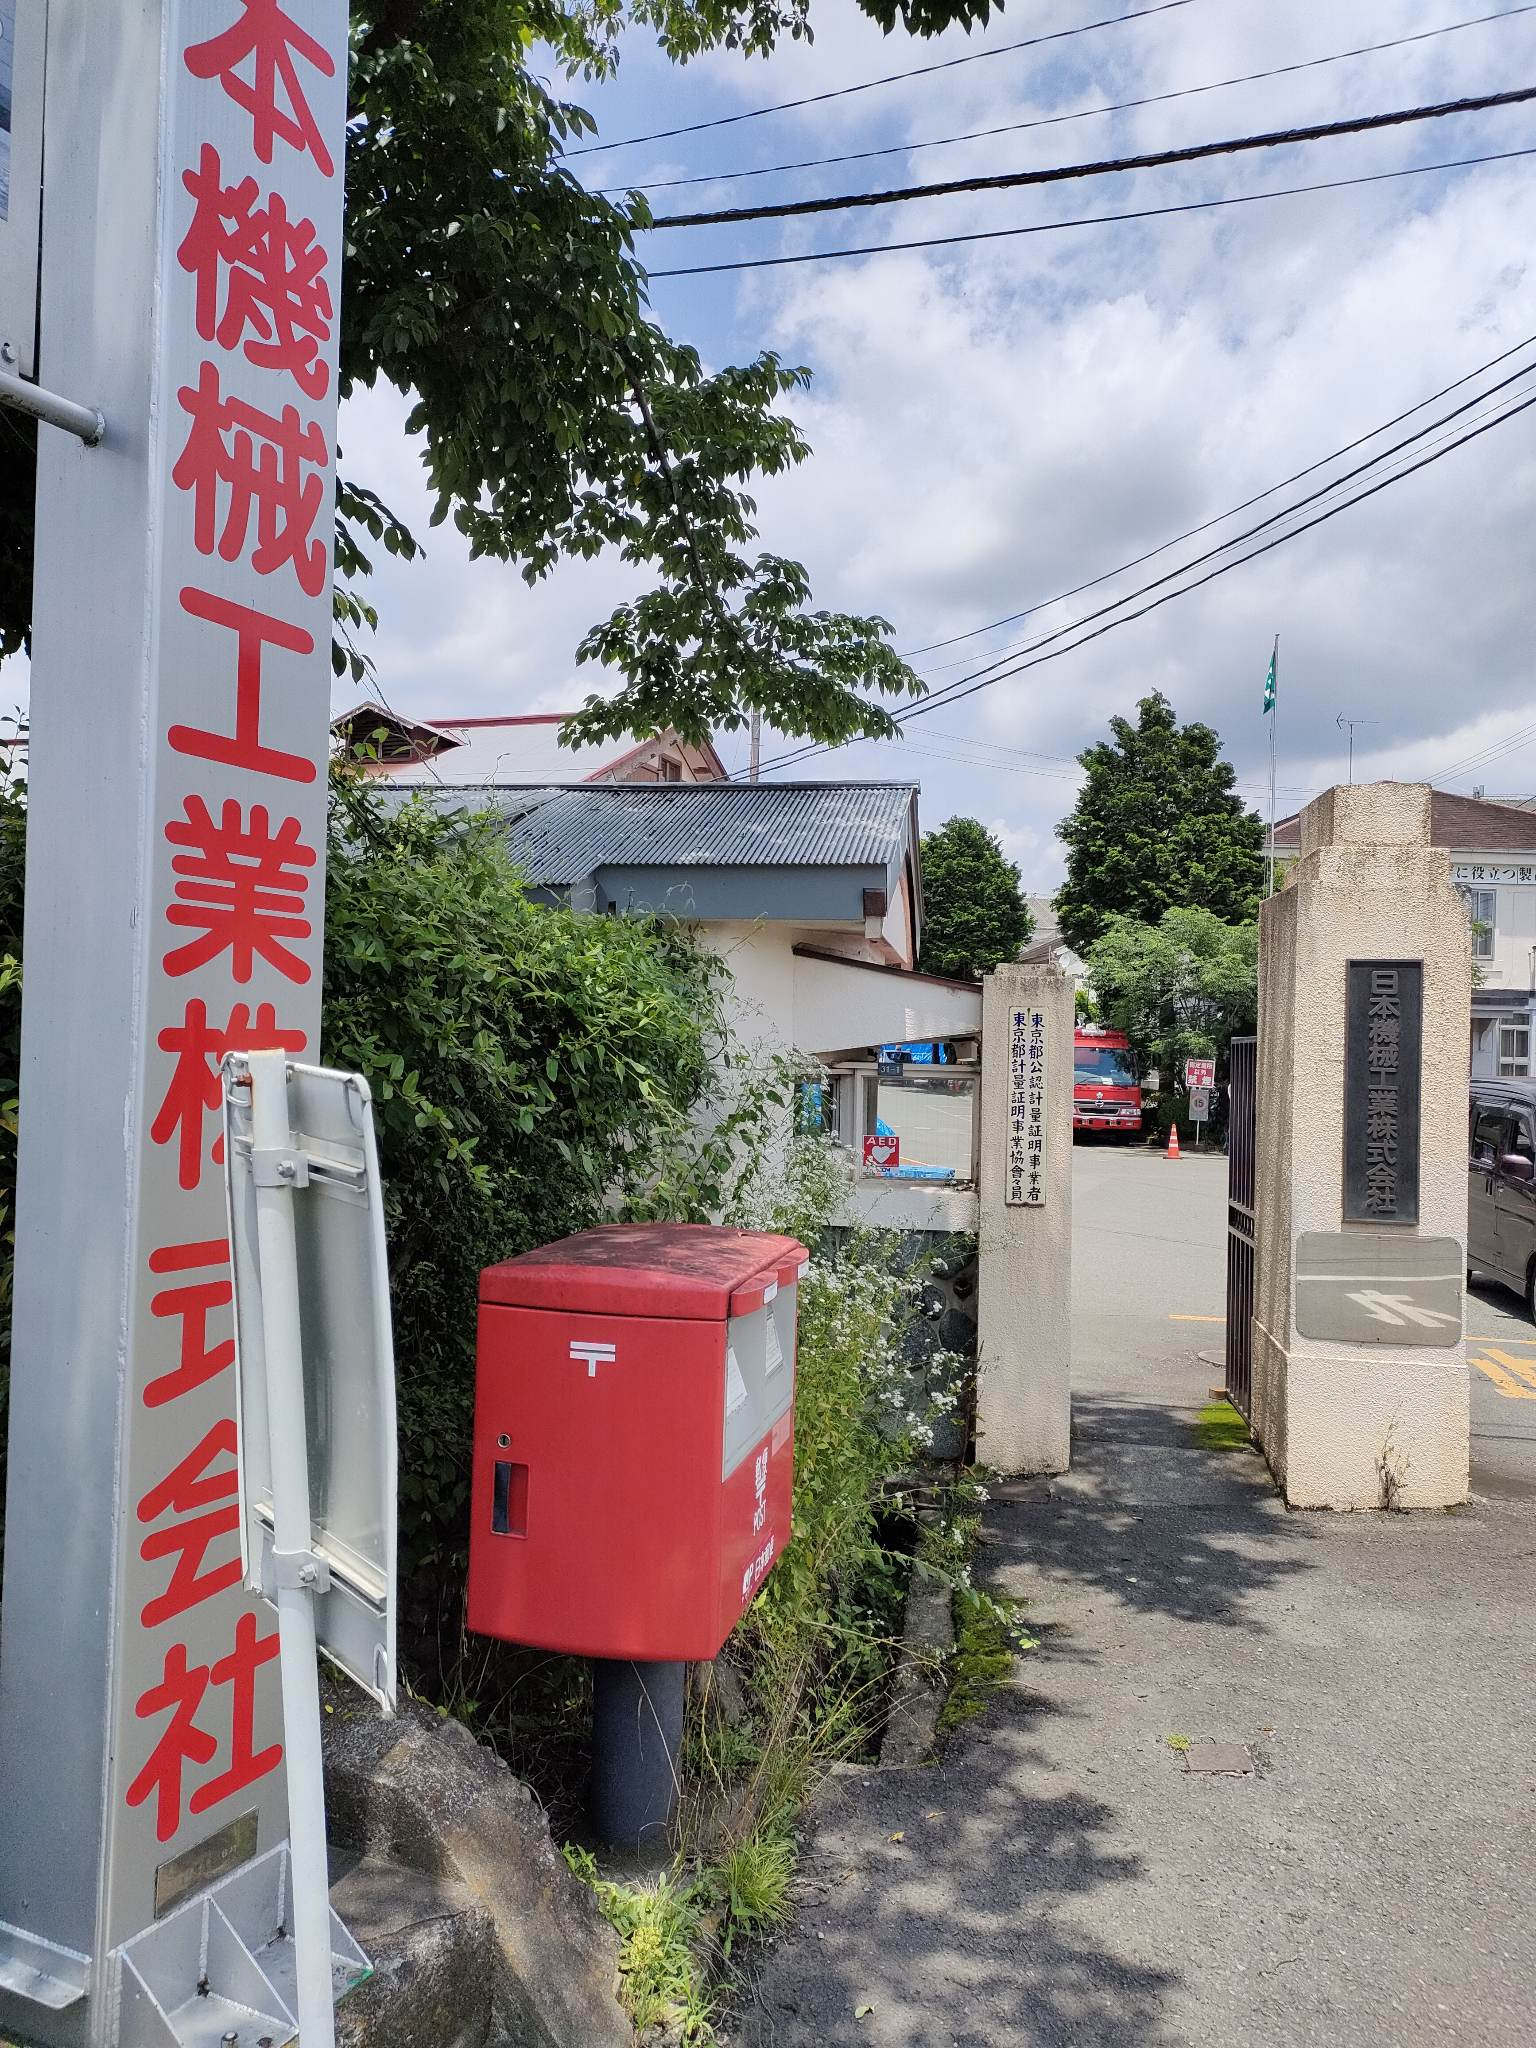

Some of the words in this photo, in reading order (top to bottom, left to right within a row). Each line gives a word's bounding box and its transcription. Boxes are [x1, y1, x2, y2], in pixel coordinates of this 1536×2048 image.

[1456, 866, 1536, 881] に役立つ製
[866, 1137, 897, 1146] AED
[1027, 1013, 1045, 1201] 東京都公認計量証明事業者
[1366, 970, 1400, 1214] 日本機械工業株式会社
